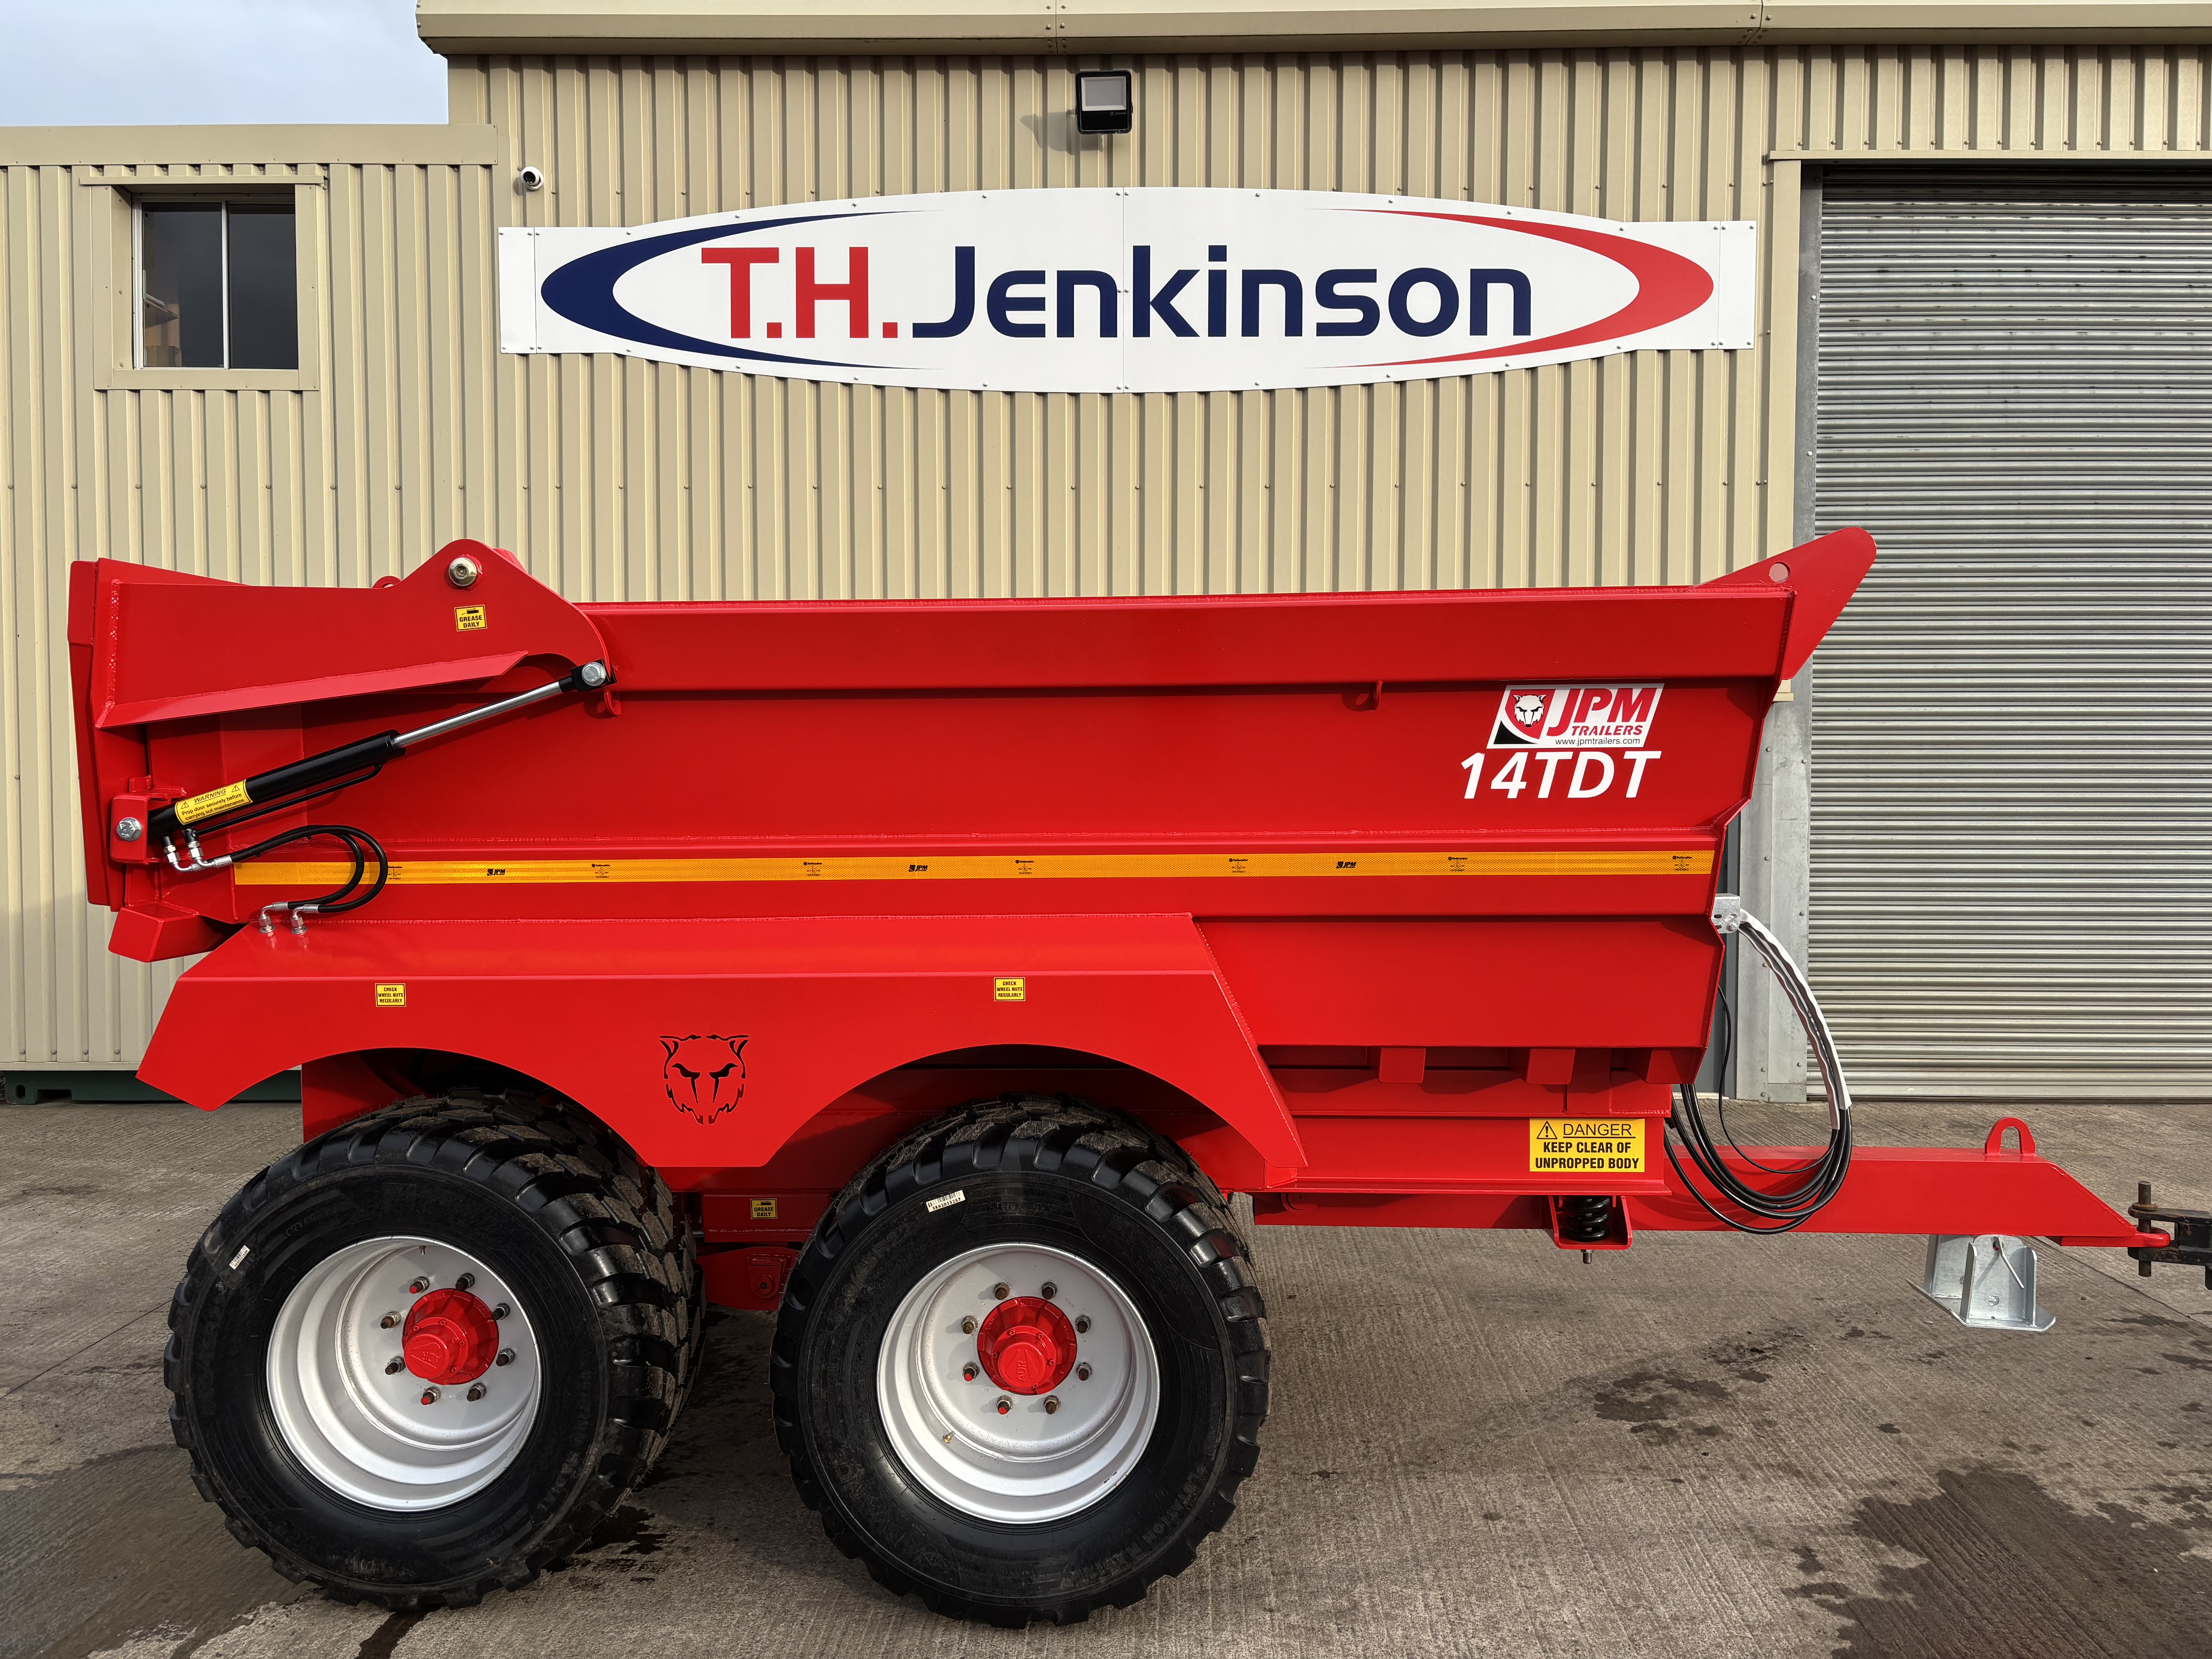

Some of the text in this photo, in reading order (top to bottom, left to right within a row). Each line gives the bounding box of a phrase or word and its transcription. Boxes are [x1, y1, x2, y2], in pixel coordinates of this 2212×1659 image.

[701, 245, 1532, 339] T.H. Jenkinson
[1546, 687, 1658, 736] JPM
[1571, 725, 1644, 736] TRAILERS
[1555, 737, 1640, 747] www.jpmtrailers.com
[1460, 750, 1662, 799] 14TDT
[194, 788, 226, 804] WARNING
[206, 798, 226, 808] securely
[226, 793, 242, 801] before
[185, 811, 205, 821] carrying
[214, 799, 245, 811] maintenance
[1563, 1123, 1632, 1136] DANGER
[1544, 1142, 1631, 1153] KEEP CLEAR OF
[1535, 1158, 1639, 1169] UNPROPPED BODY
[1016, 1360, 1027, 1382] ADR
